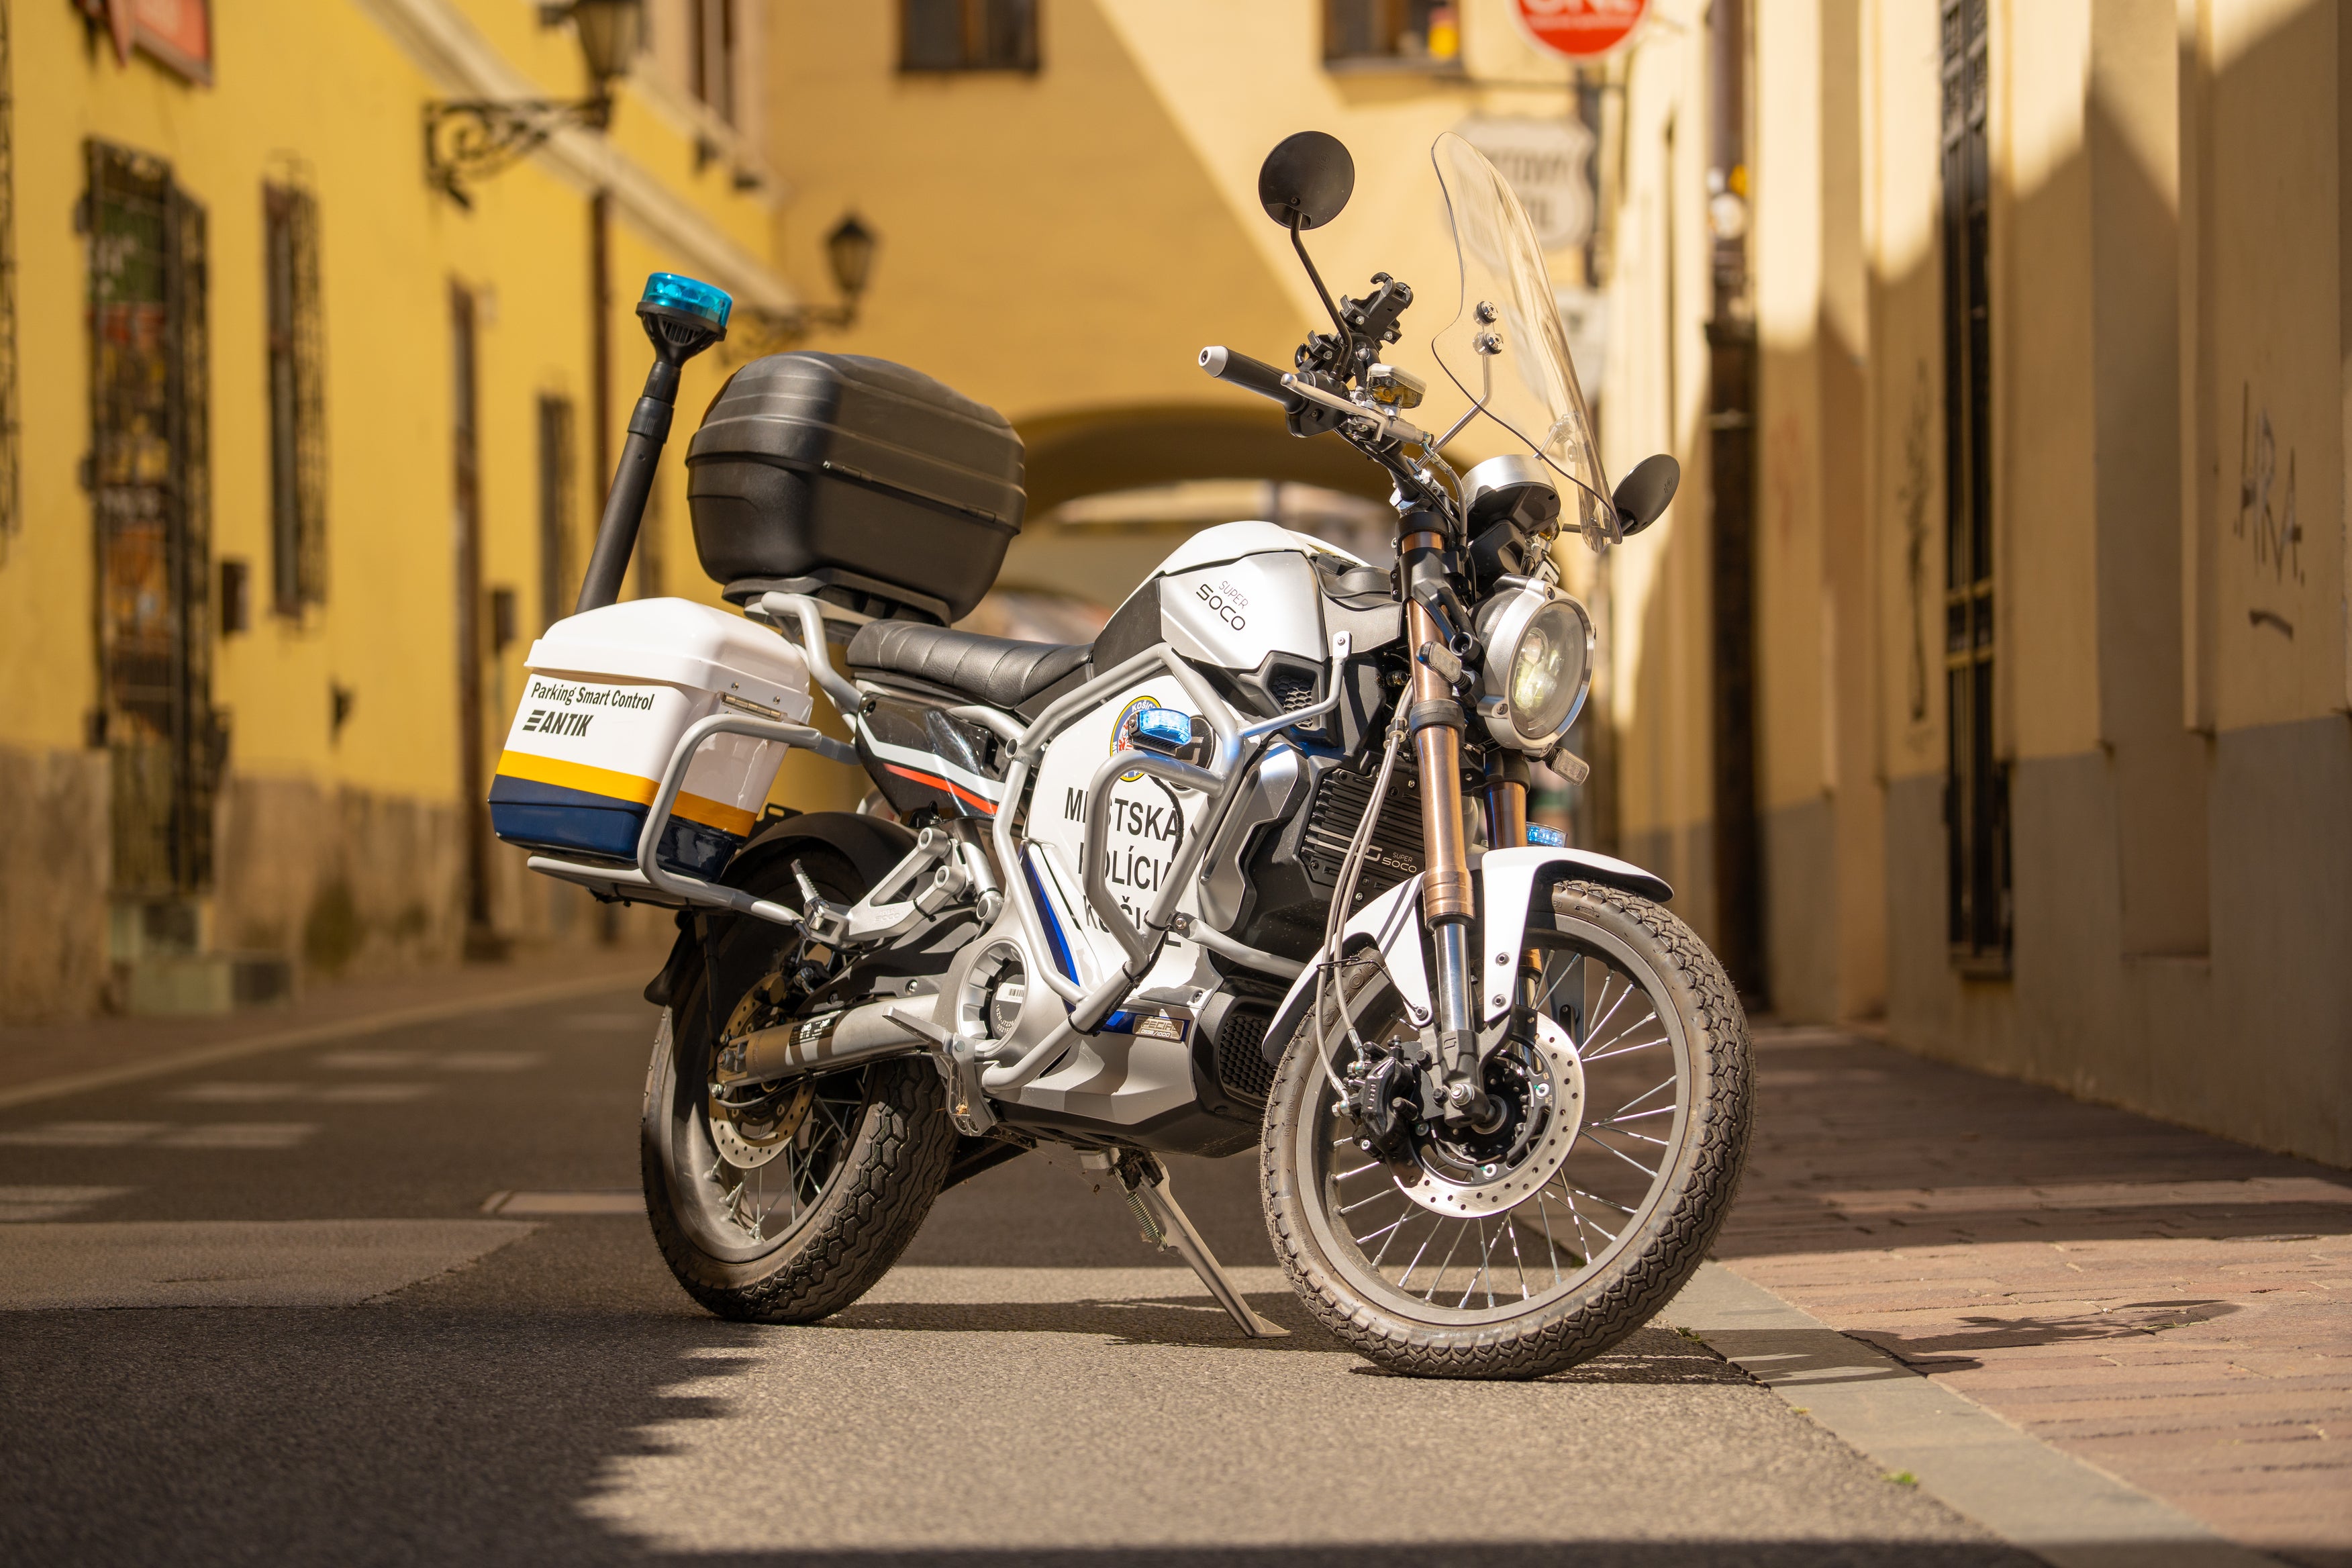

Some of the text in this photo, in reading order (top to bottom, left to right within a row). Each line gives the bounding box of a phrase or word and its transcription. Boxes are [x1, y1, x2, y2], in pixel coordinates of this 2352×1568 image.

[1218, 581, 1248, 609] SUPER
[1195, 583, 1246, 631] SOCO
[531, 682, 655, 710] Parking Smart Control
[1132, 700, 1156, 712] KOŠIC
[1381, 856, 1417, 873] SOCO
[1392, 852, 1413, 863] SUPER
